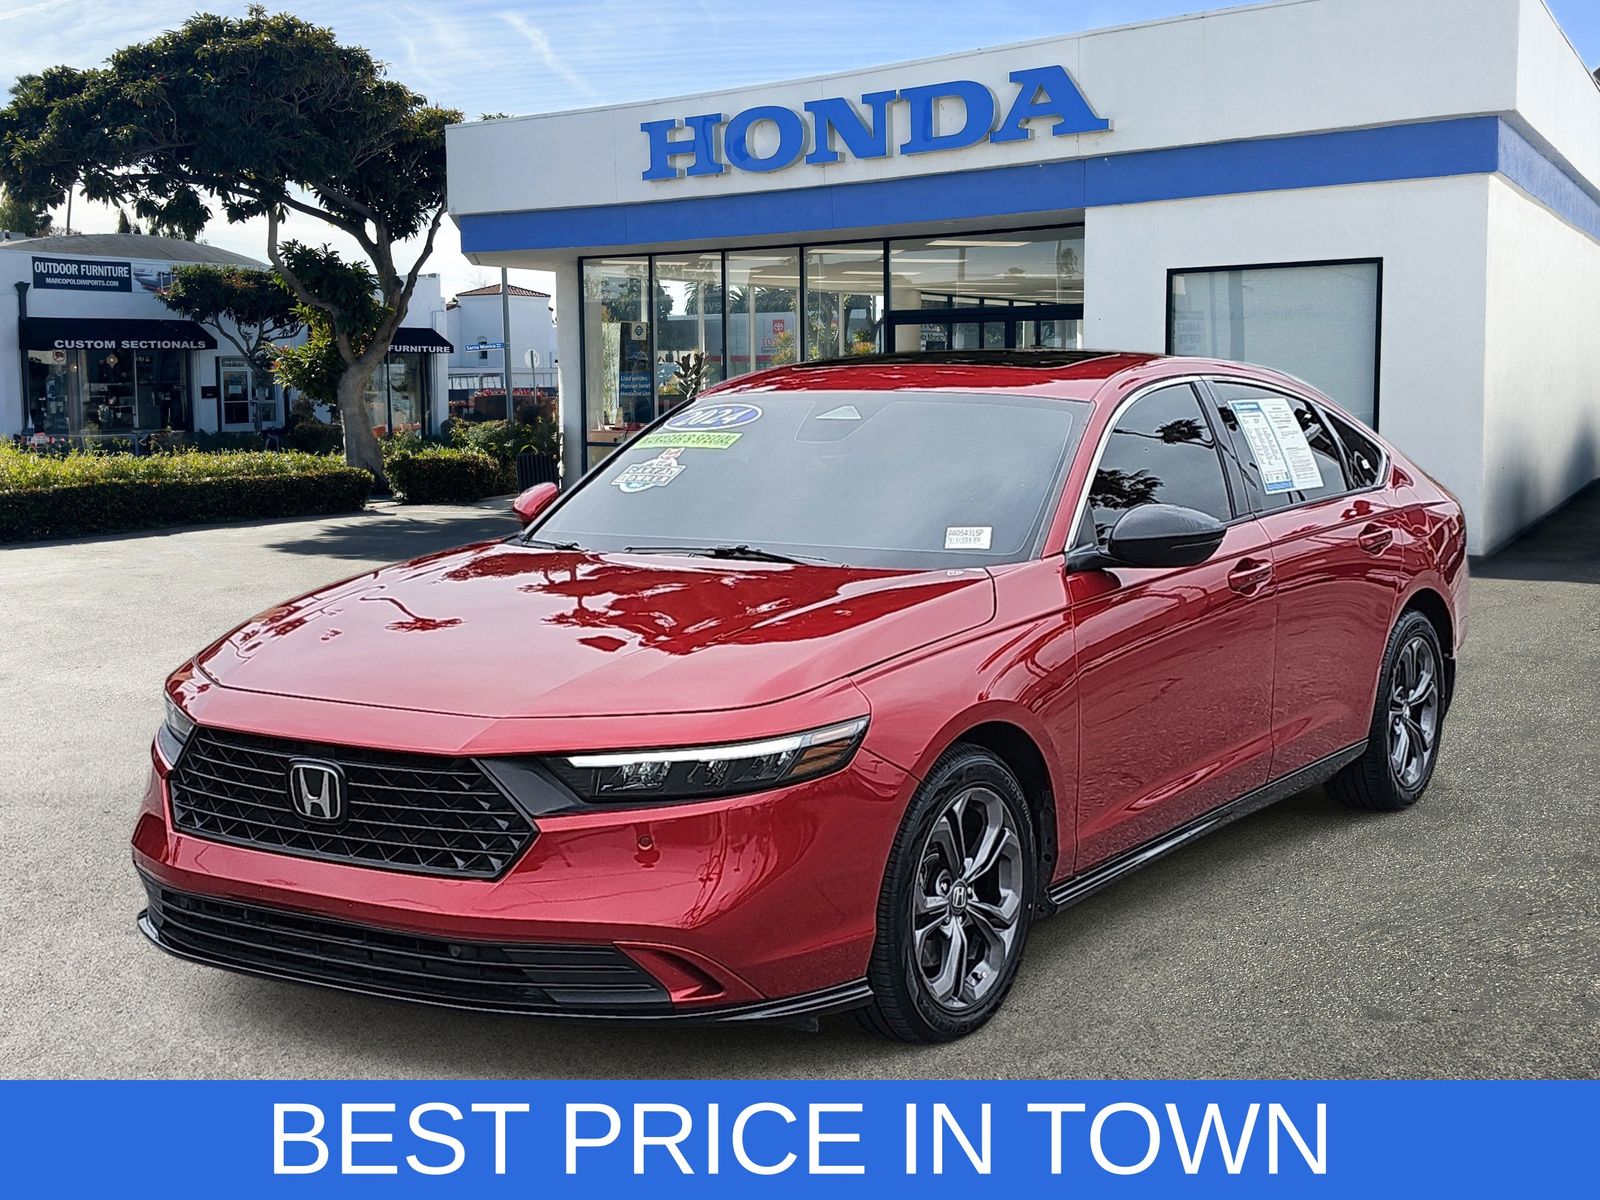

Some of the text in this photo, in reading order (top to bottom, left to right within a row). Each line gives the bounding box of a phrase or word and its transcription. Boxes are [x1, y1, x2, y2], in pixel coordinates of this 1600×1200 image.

[641, 64, 1110, 181] HONDA
[34, 261, 130, 278] OUTDOOR FURNITURE
[45, 277, 120, 288] MARCOPOLOIMPORTS.COM
[54, 338, 207, 350] CUSTOM SECTIONALS
[388, 344, 451, 354] FURNITURE
[670, 409, 753, 427] 2024
